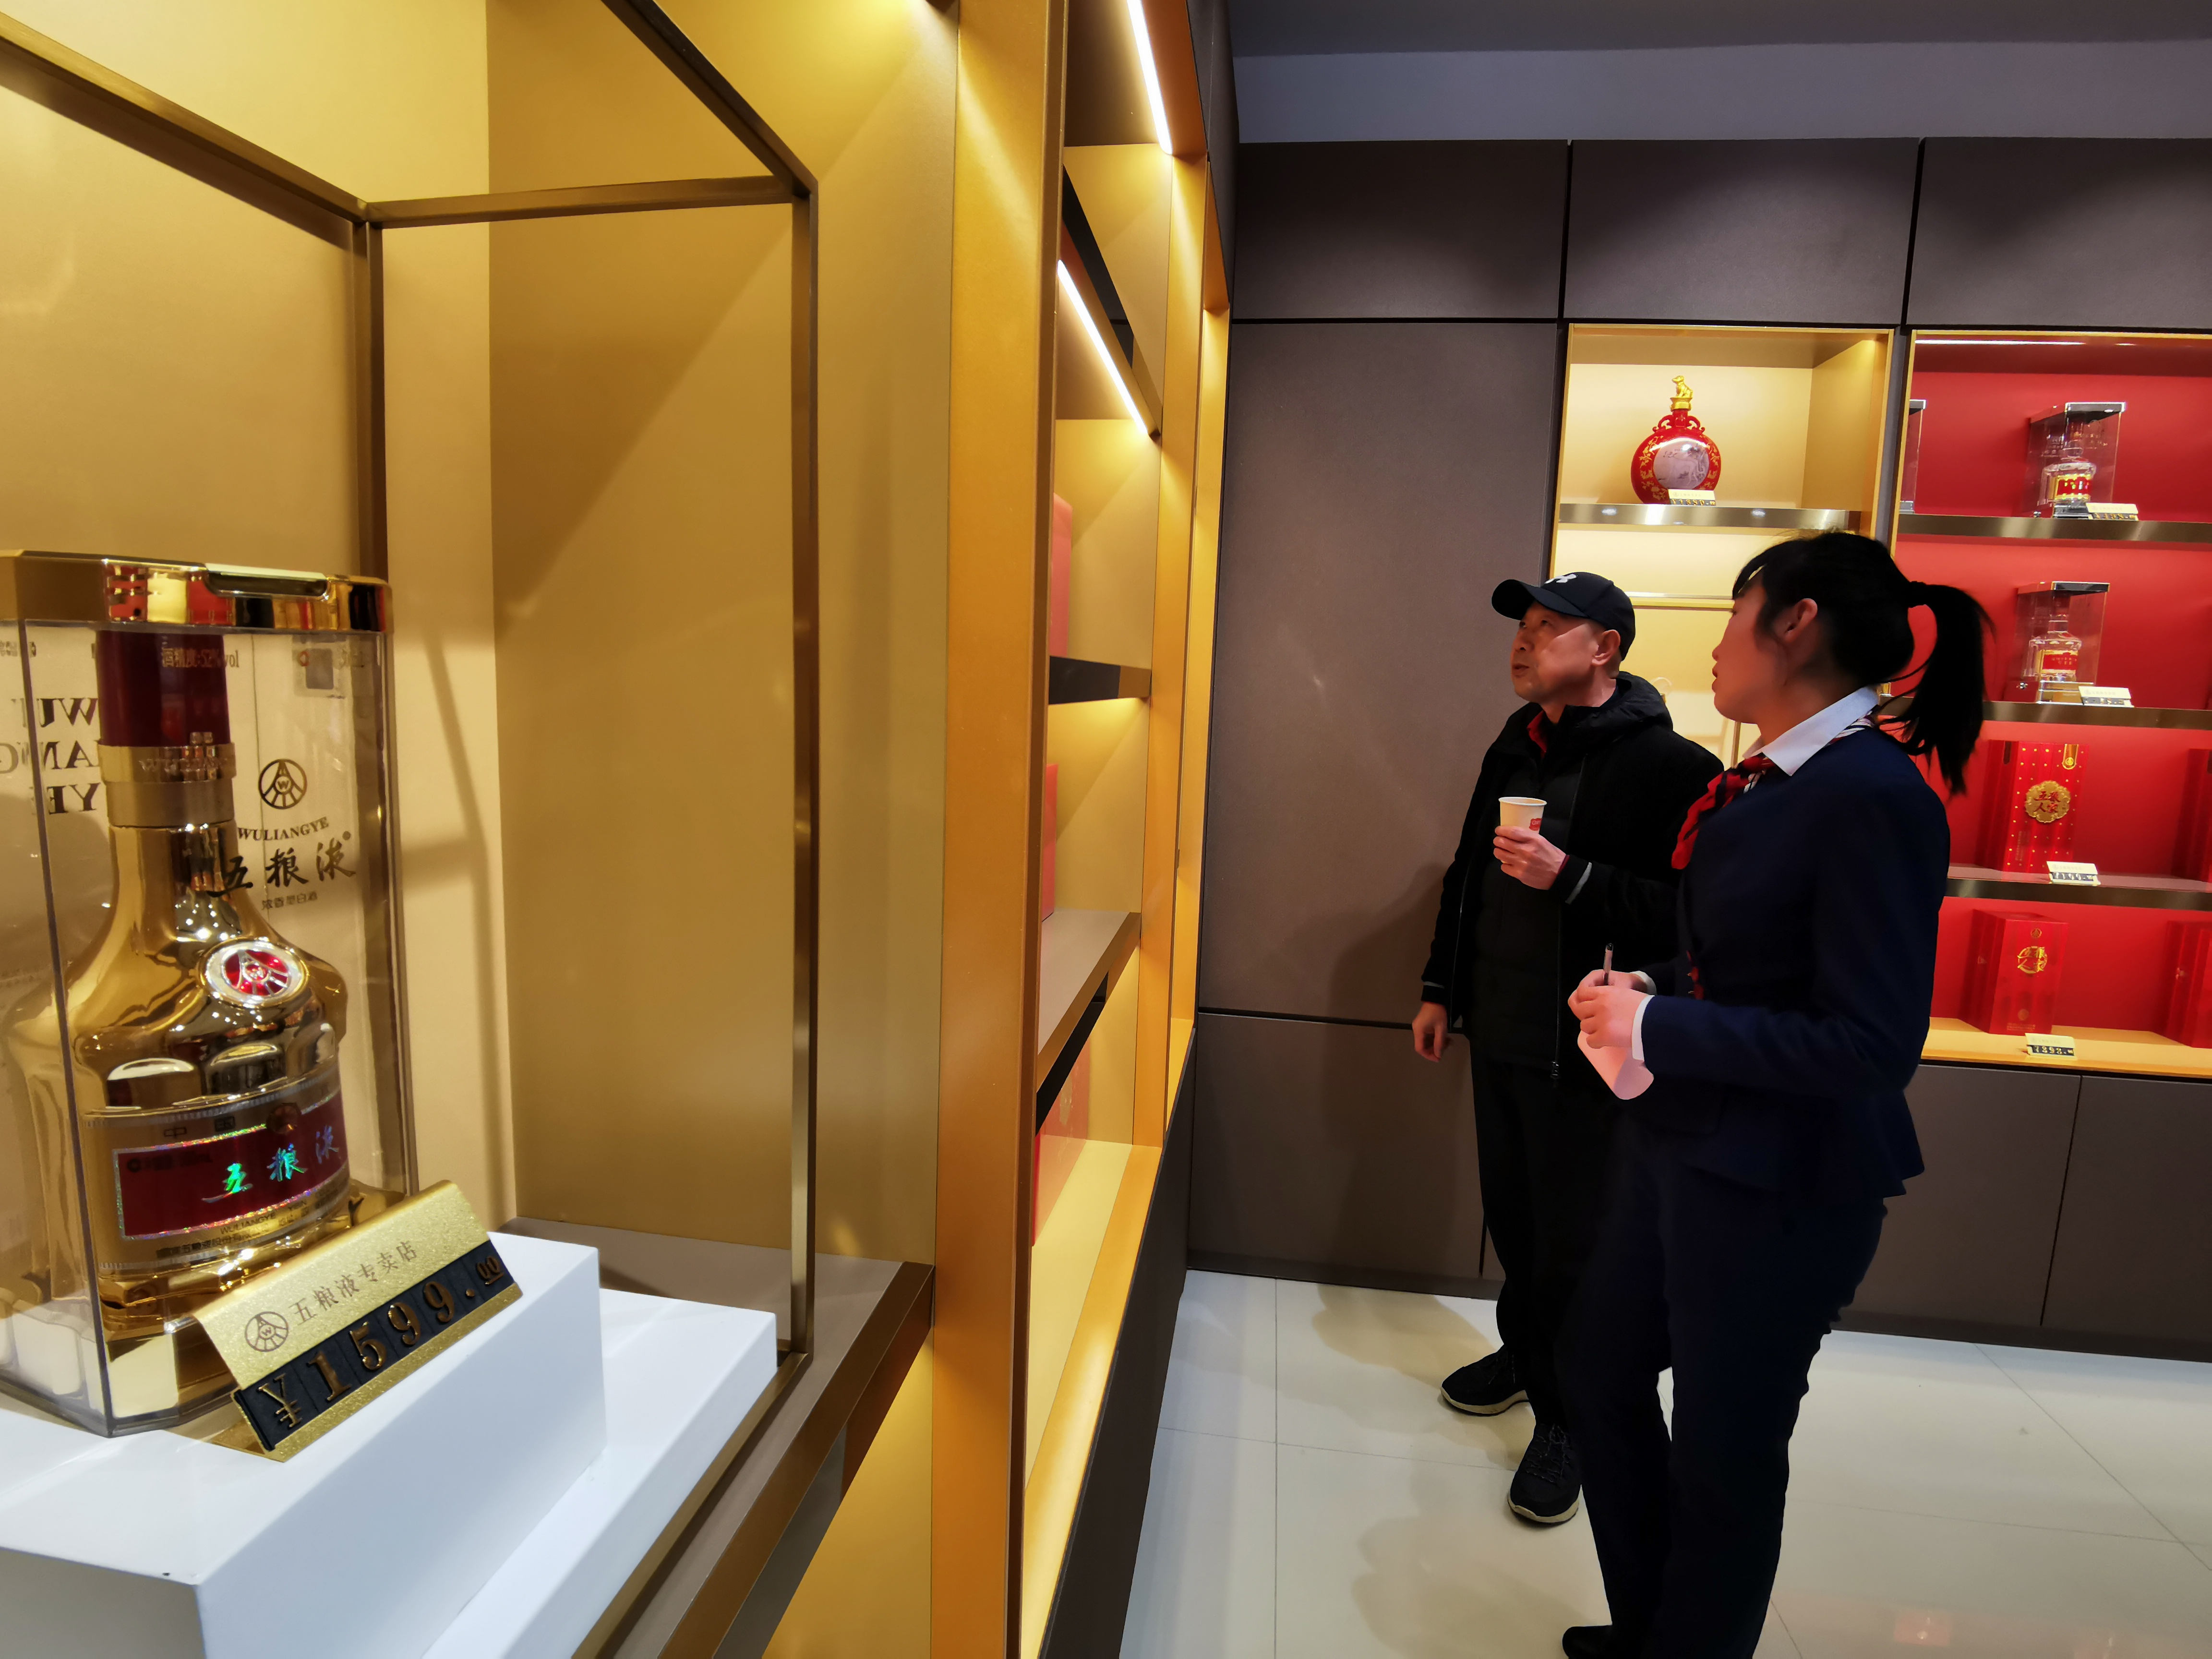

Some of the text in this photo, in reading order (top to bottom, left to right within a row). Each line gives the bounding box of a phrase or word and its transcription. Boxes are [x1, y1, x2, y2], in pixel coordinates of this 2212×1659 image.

[238, 817, 329, 841] WULIANGYE
[206, 837, 356, 898] 五粮液
[201, 1125, 339, 1203] 五粮液
[288, 1240, 418, 1326] 五粮液专卖店
